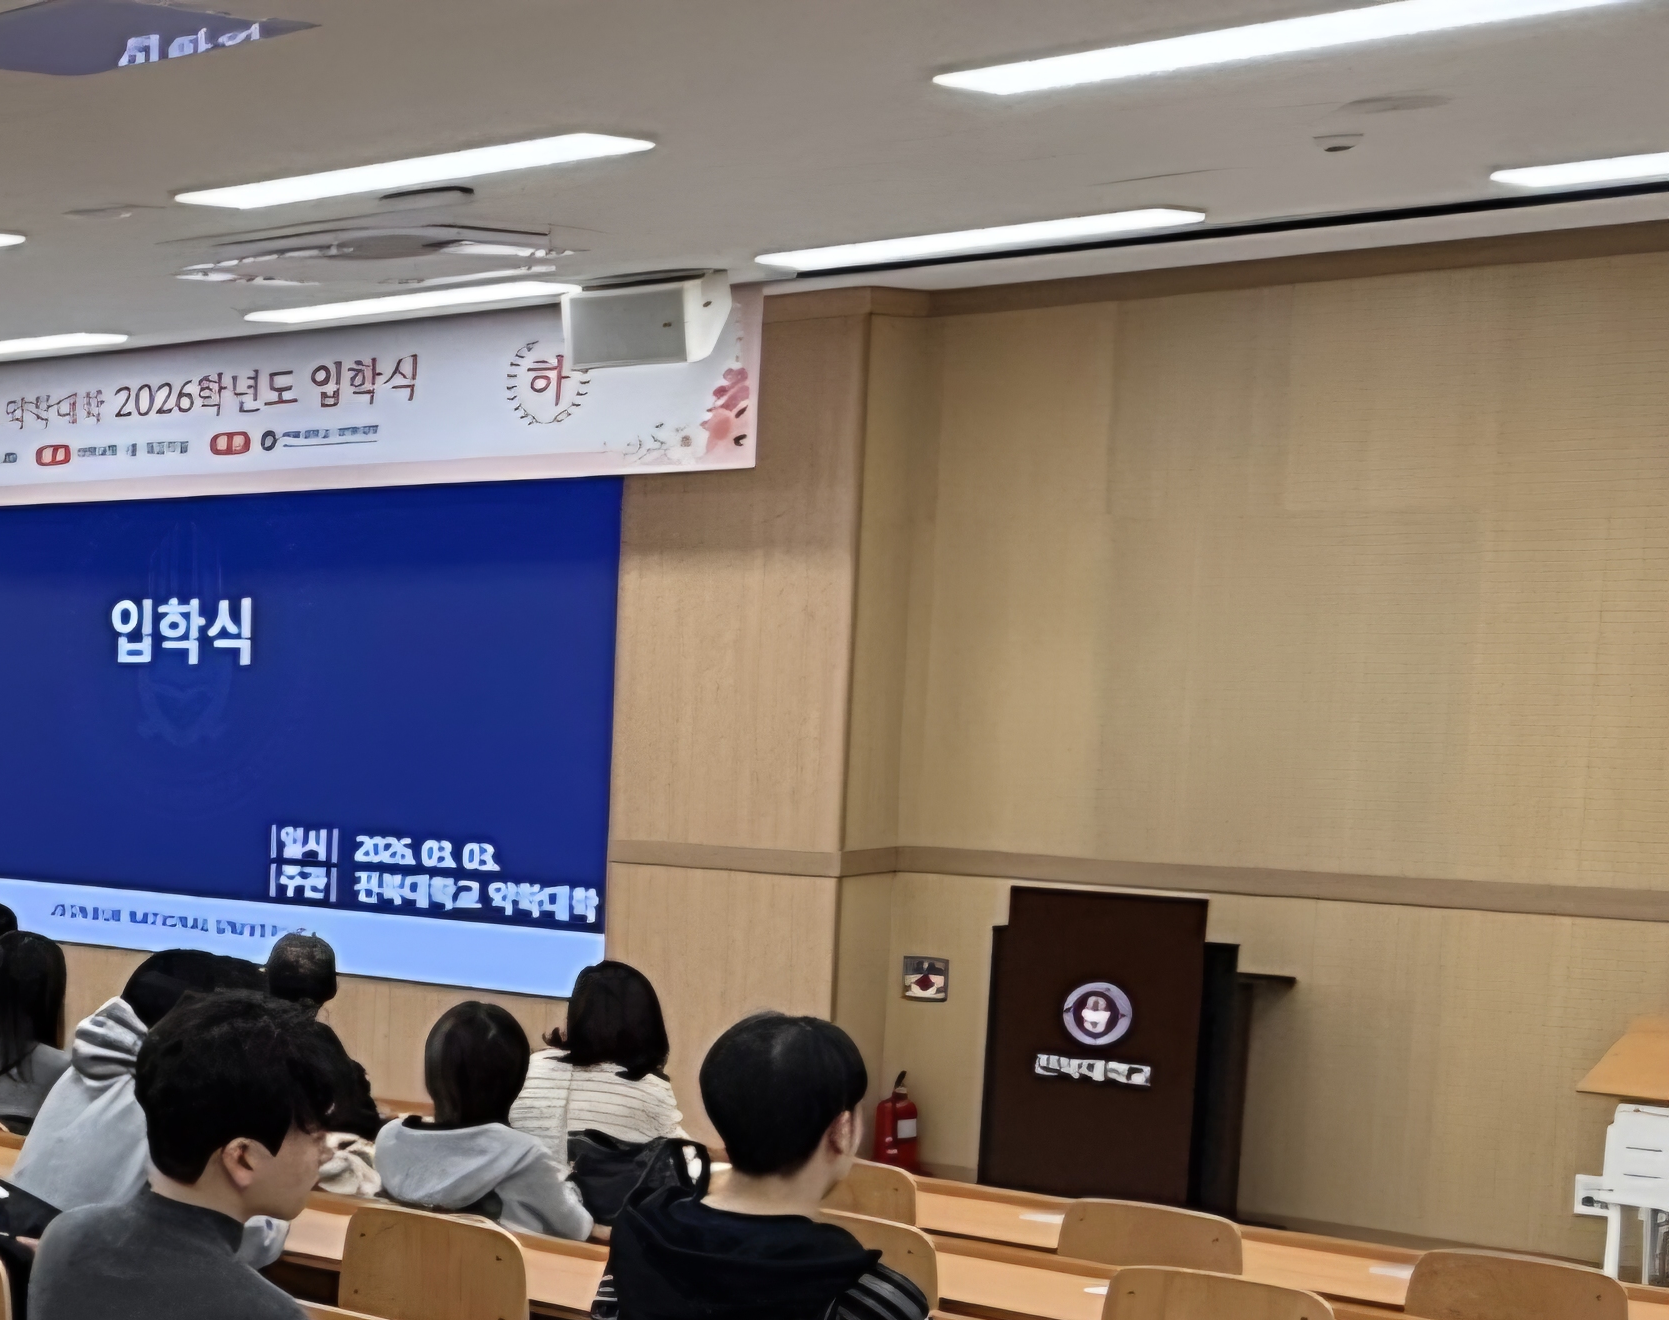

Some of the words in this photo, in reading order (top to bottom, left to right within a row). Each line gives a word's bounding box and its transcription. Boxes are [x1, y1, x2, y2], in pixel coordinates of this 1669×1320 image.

[114, 369, 298, 417] 2026학년도
[310, 353, 418, 409] 입학식
[527, 354, 571, 407] 하
[111, 597, 253, 666] 입학식
